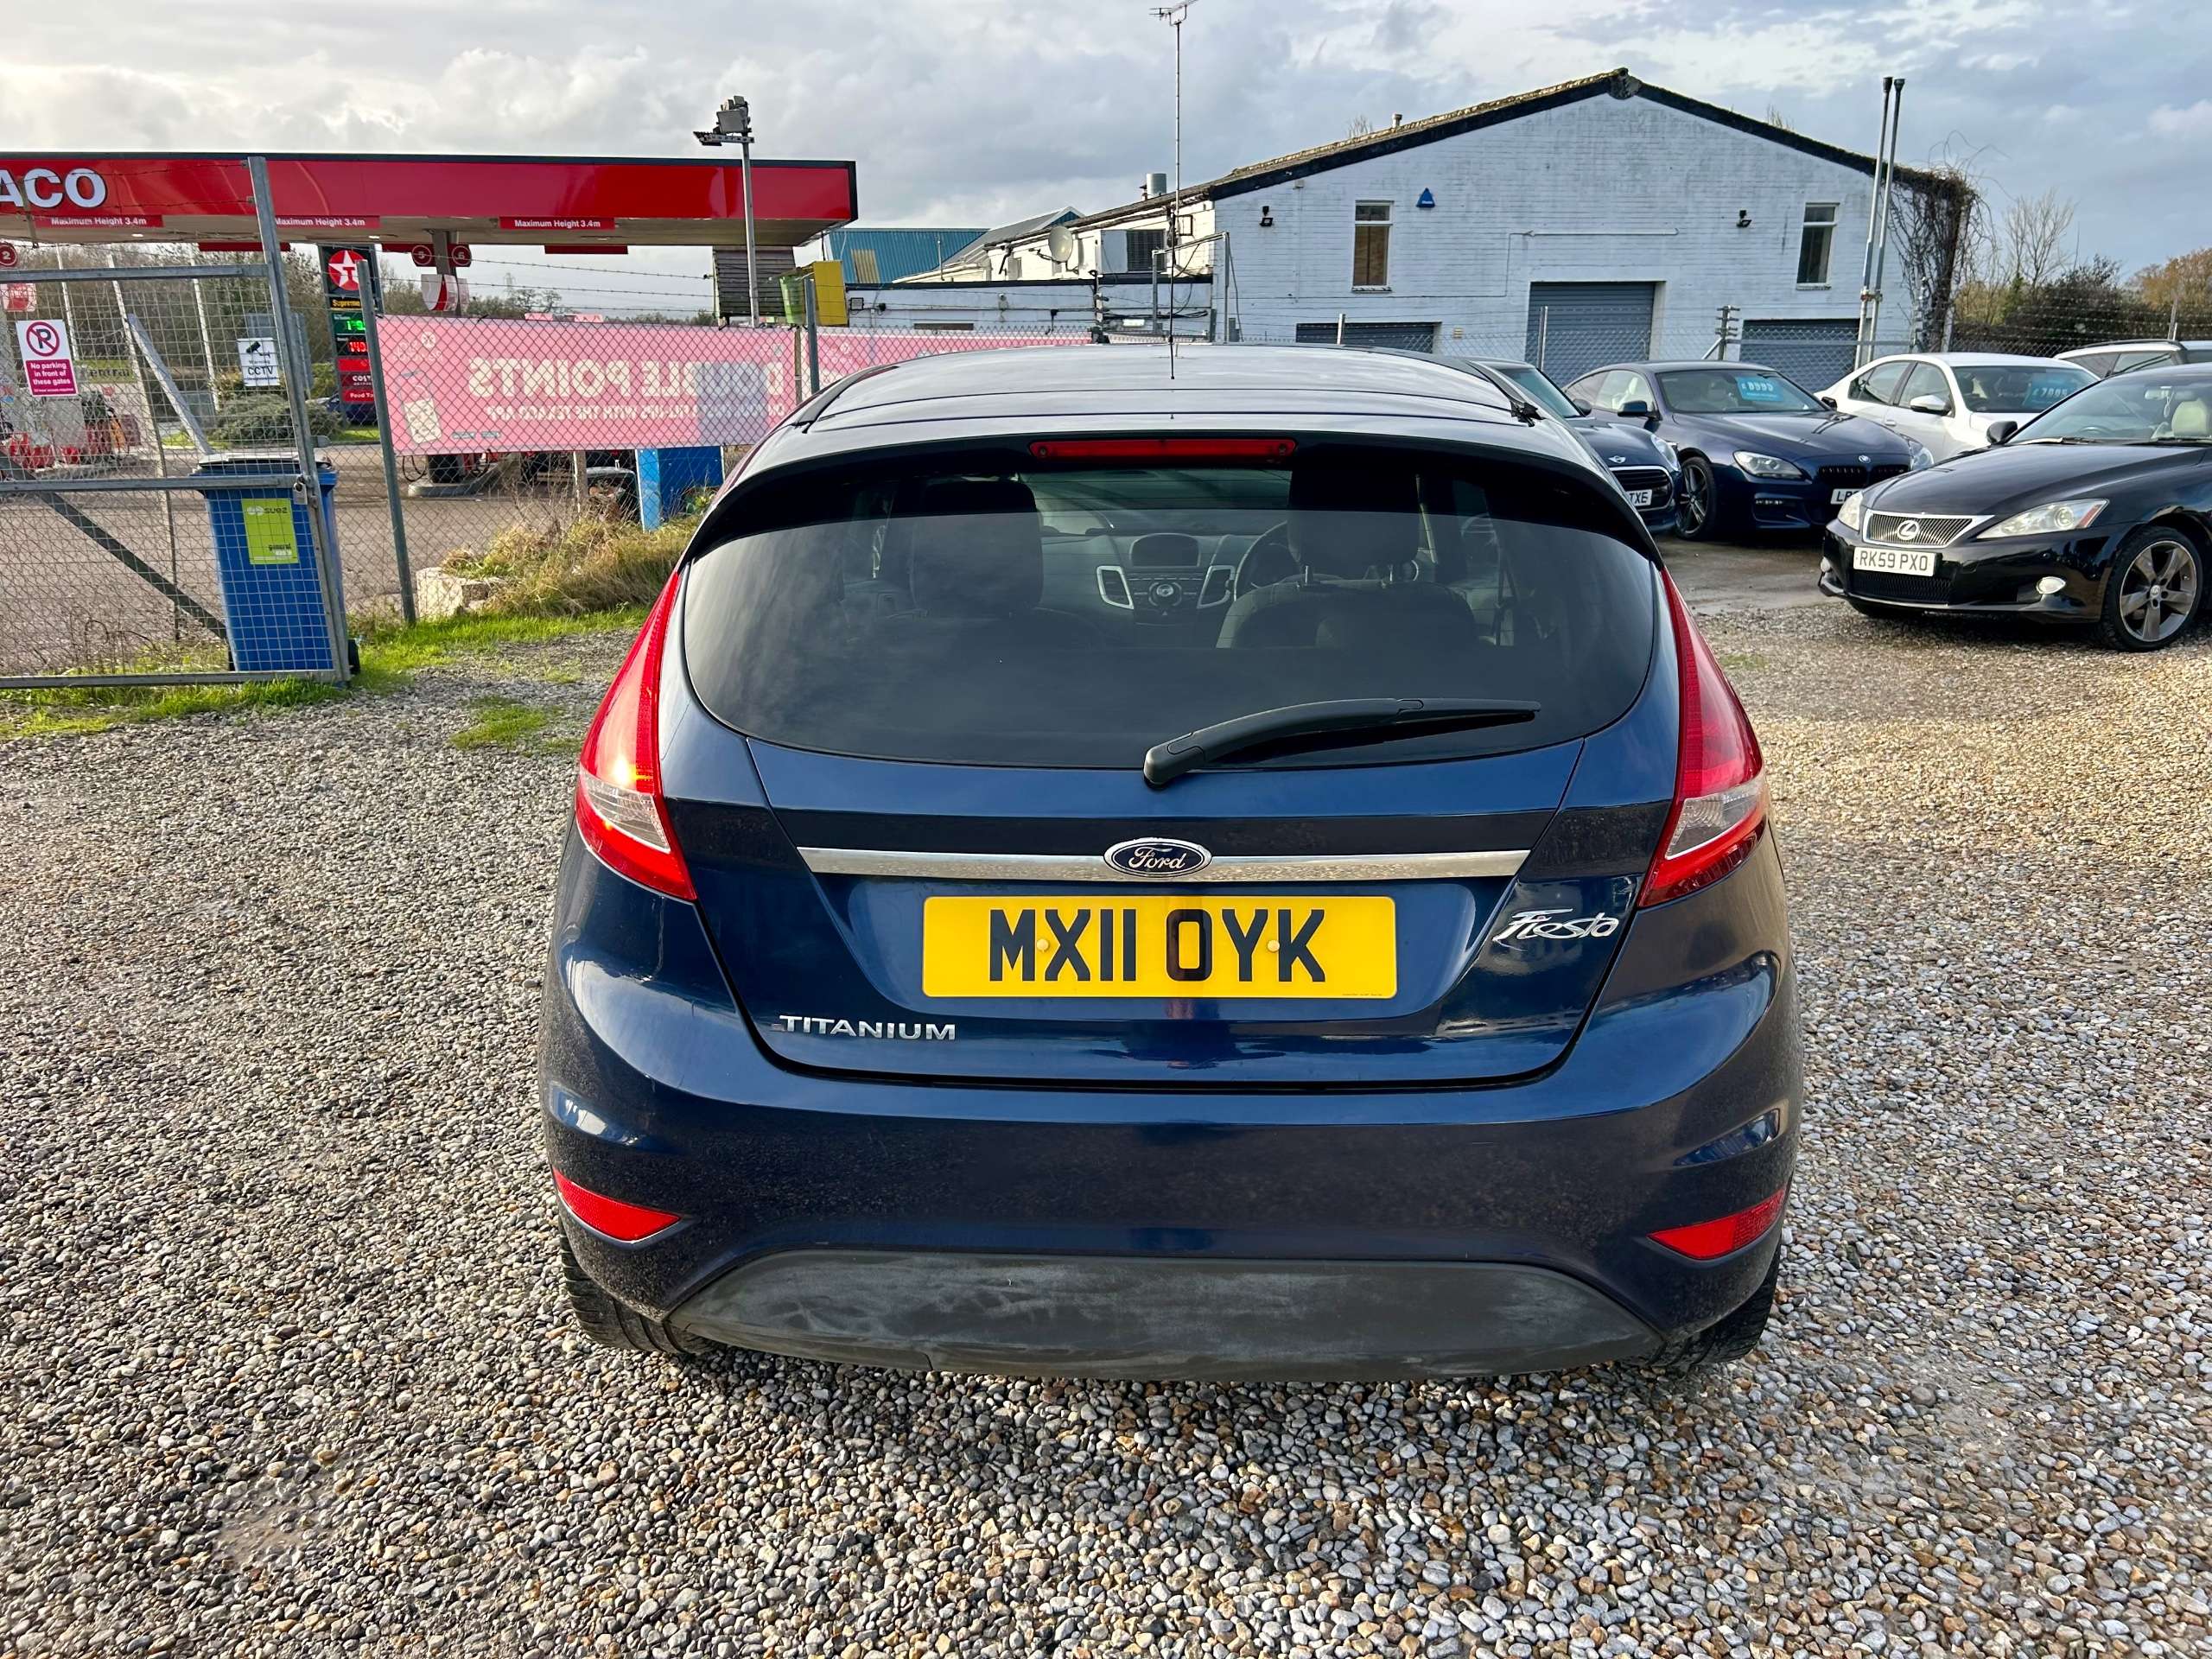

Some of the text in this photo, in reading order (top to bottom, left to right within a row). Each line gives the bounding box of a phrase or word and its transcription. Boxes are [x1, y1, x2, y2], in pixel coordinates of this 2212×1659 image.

[51, 217, 147, 227] Maximum Height 3.4m
[315, 218, 343, 227] Height
[345, 218, 365, 226] 3.4m
[554, 219, 580, 229] Height
[41, 362, 67, 371] parking
[247, 365, 274, 376] CCTV
[1630, 492, 1649, 504] TXE
[1859, 550, 1929, 571] RK59 PXO
[1128, 846, 1187, 869] Ford
[1491, 908, 1620, 943] Fiesta
[988, 908, 1326, 983] MX11 OYK
[779, 1014, 957, 1040] TITANIUM
